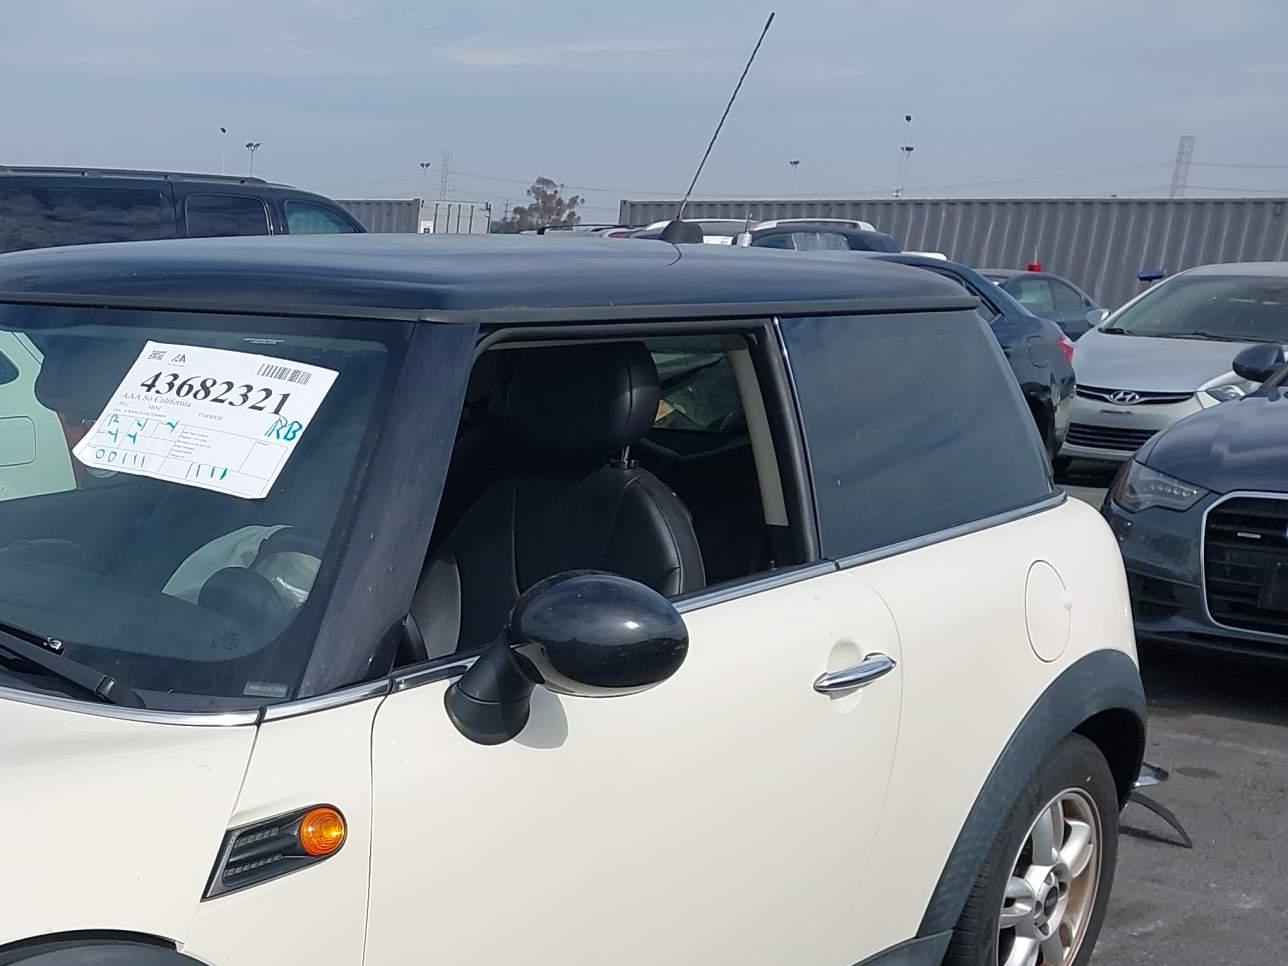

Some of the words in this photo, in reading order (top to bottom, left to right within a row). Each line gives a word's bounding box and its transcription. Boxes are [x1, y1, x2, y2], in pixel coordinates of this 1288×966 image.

[122, 392, 141, 401] AAA
[142, 394, 153, 402] So
[154, 395, 192, 408] California
[140, 371, 292, 416] 43682321
